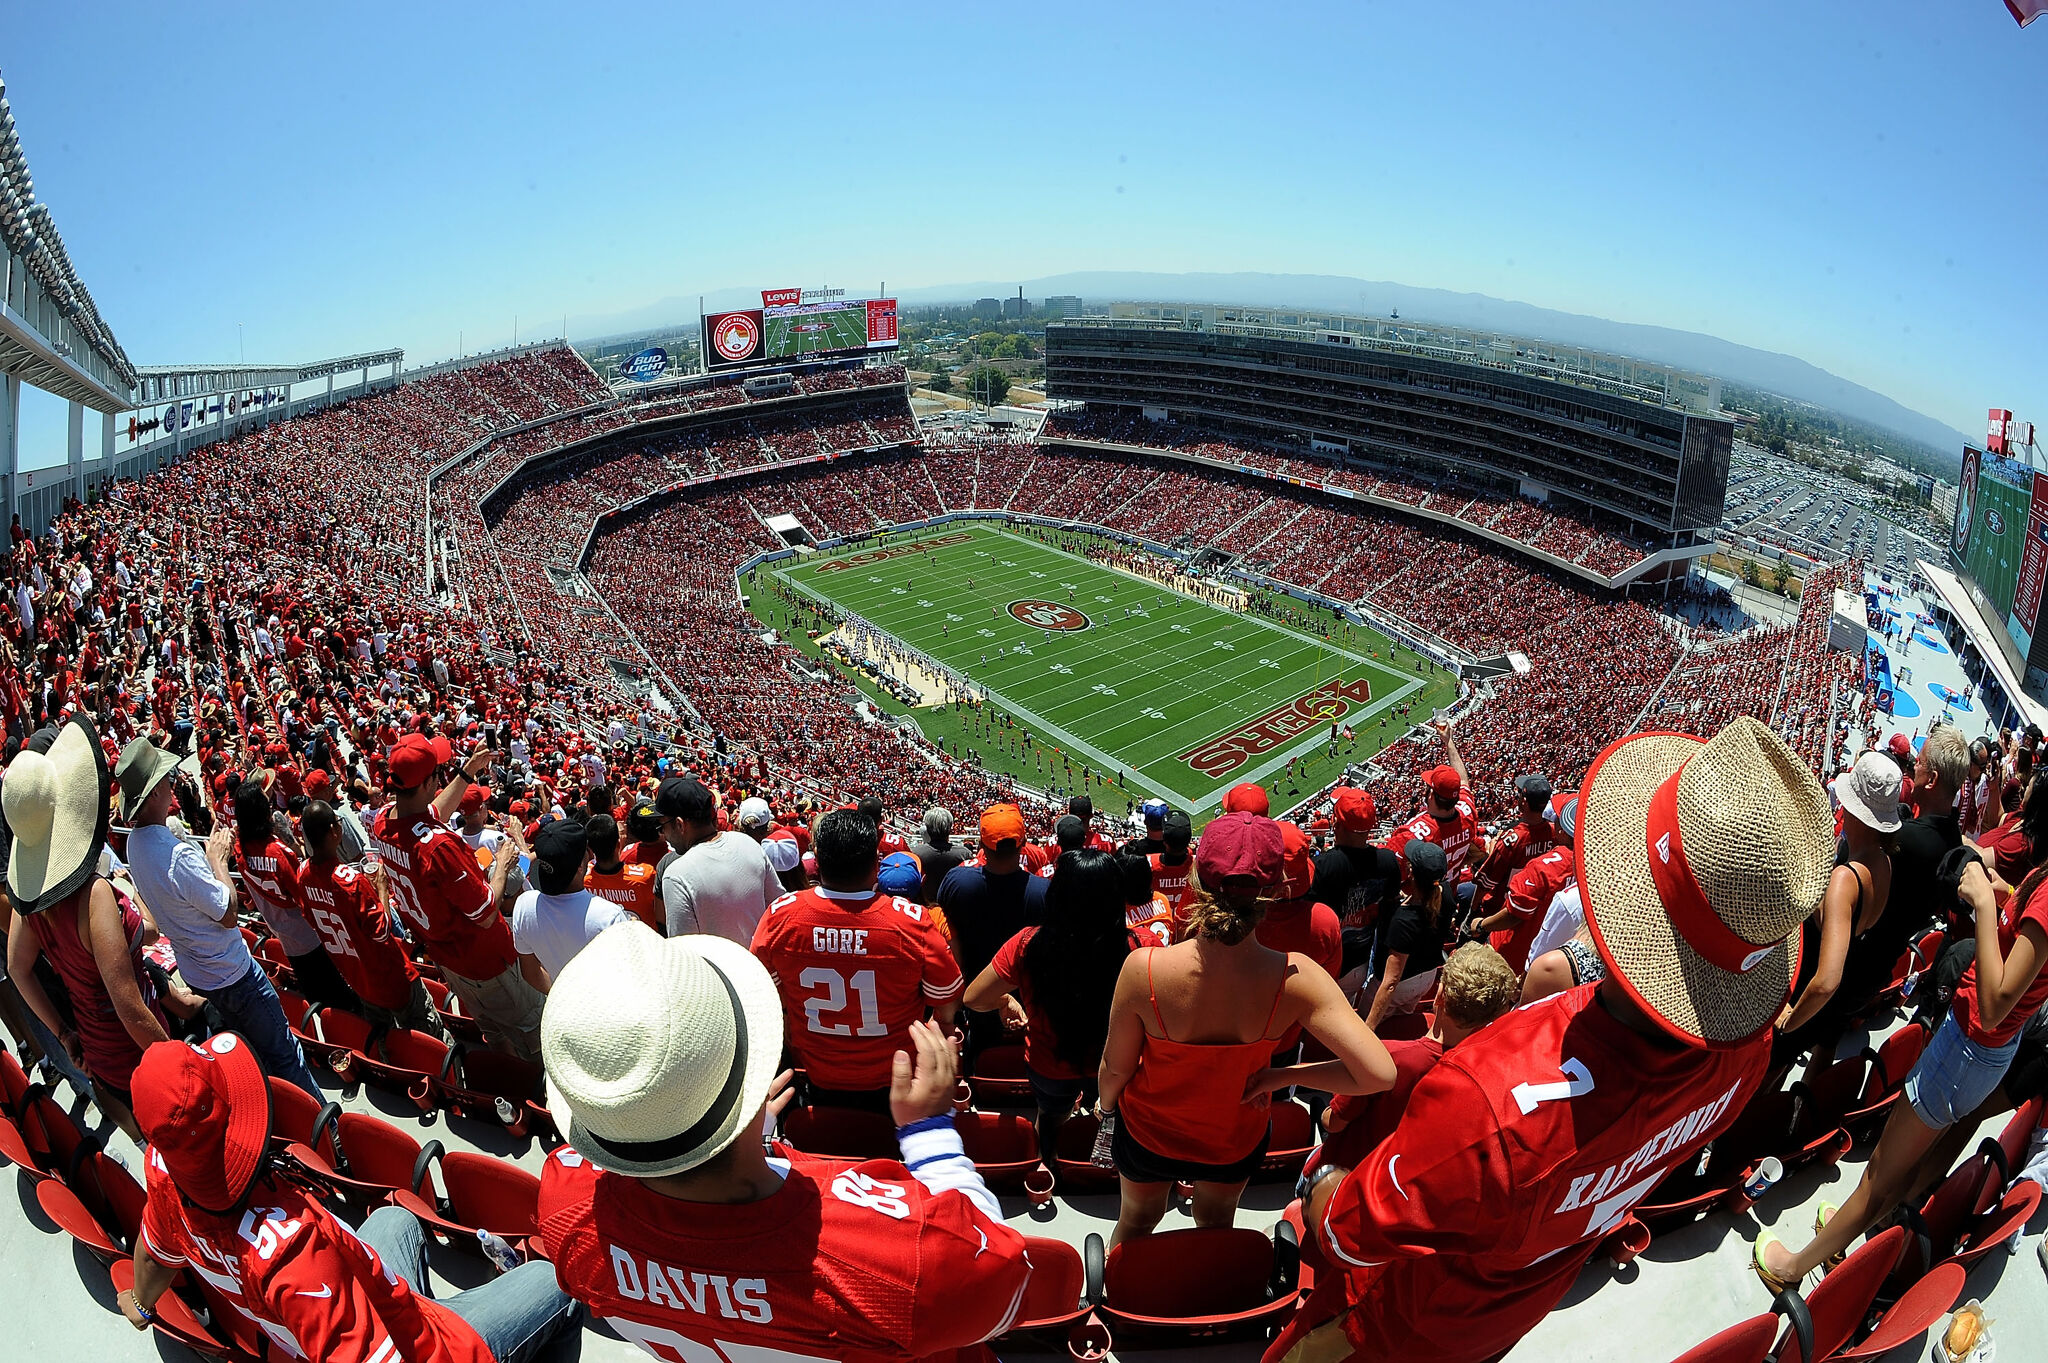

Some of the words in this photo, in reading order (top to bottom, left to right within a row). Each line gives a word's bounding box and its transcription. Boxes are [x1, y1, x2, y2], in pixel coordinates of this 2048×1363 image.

[628, 361, 666, 374] LIGHT
[634, 355, 662, 366] BUD
[796, 353, 820, 361] SONY
[1421, 648, 1454, 670] CHAMPINS
[1175, 678, 1372, 779] 49ERS
[1409, 820, 1432, 841] 52
[1442, 828, 1470, 851] WILLIS
[1525, 840, 1554, 857] WILLIS
[1542, 852, 1563, 868] 7
[1159, 877, 1187, 888] WILLIS
[305, 885, 336, 907] WILLIS
[312, 907, 361, 960] 52
[812, 926, 869, 955] GORE
[799, 966, 889, 1036] 21
[1511, 1056, 1595, 1116] 7
[831, 1168, 911, 1220] 85
[237, 1206, 302, 1260] 52
[609, 1243, 774, 1324] DAVIS
